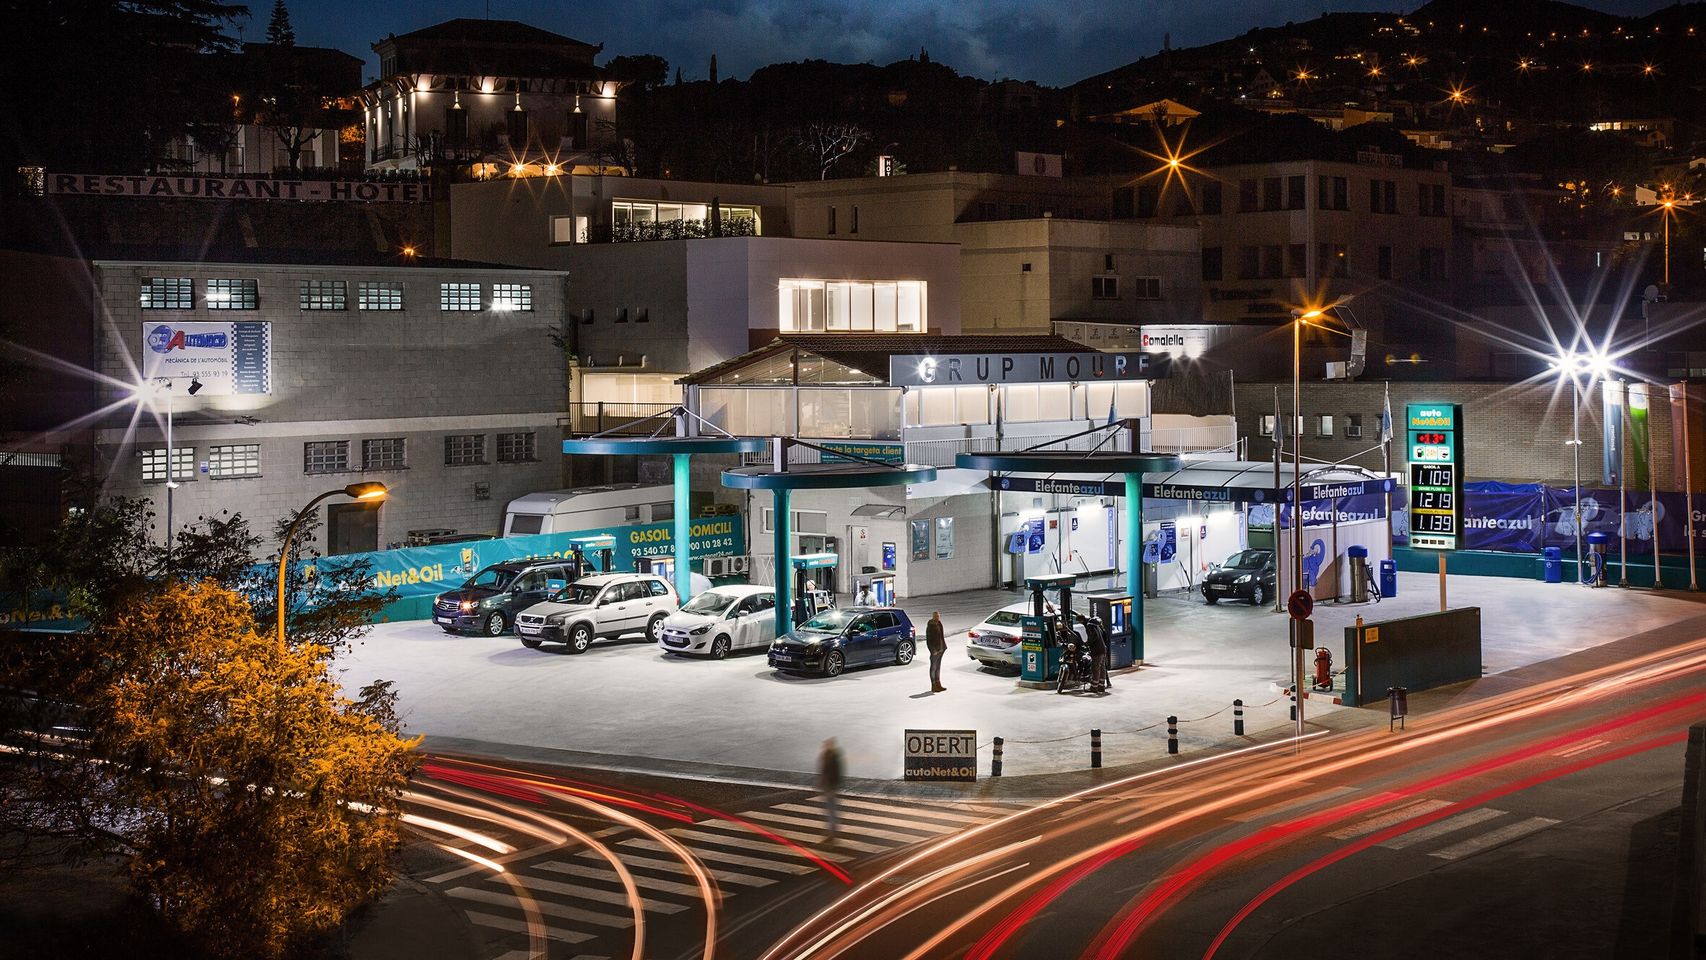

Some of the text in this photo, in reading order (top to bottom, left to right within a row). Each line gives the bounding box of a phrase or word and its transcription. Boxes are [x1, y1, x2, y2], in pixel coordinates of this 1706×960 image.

[56, 175, 301, 198] RESTAURANT
[331, 182, 431, 201] HOTEL
[917, 357, 1014, 383] GRUP
[1420, 409, 1442, 417] auto
[1411, 417, 1451, 426] Net&Oil
[844, 445, 852, 453] la
[853, 446, 880, 455] targeta
[1419, 470, 1451, 485] 1.109
[1035, 480, 1104, 495] Elefanteazul
[1154, 486, 1230, 500] Elefanteazul
[1313, 482, 1365, 499] Elefanteazul
[1419, 492, 1452, 508] 1.219
[1419, 515, 1452, 531] 1.139
[1464, 514, 1532, 530] anteazul
[630, 528, 671, 543] GASOIL
[631, 547, 641, 557] 93
[643, 546, 658, 556] 540
[659, 545, 669, 554] 37
[702, 541, 711, 549] 10
[712, 540, 721, 548] 28
[723, 538, 733, 546] 42
[907, 736, 974, 754] OBERT
[906, 767, 976, 777] autoNet&Oil
